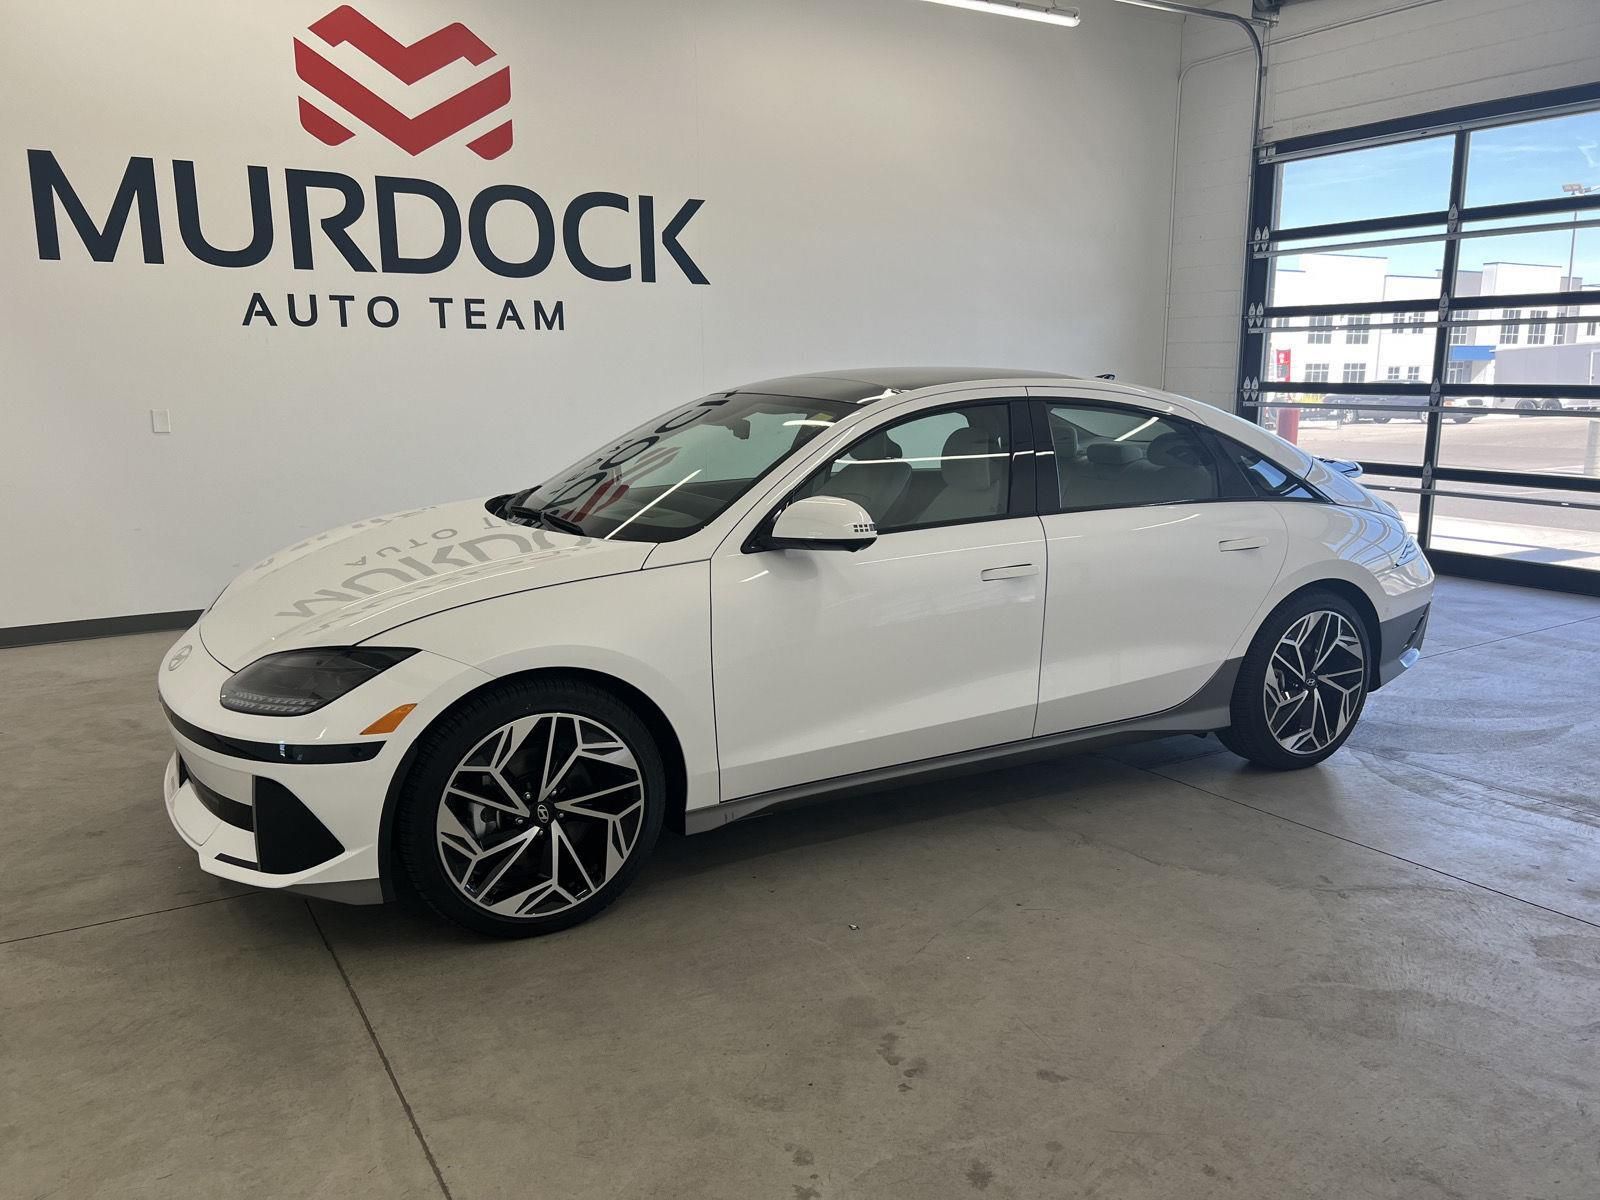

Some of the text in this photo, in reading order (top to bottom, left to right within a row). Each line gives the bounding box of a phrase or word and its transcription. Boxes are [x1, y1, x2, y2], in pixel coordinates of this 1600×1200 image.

[27, 148, 711, 286] MURDOCK
[242, 292, 565, 331] AUTO TEAM
